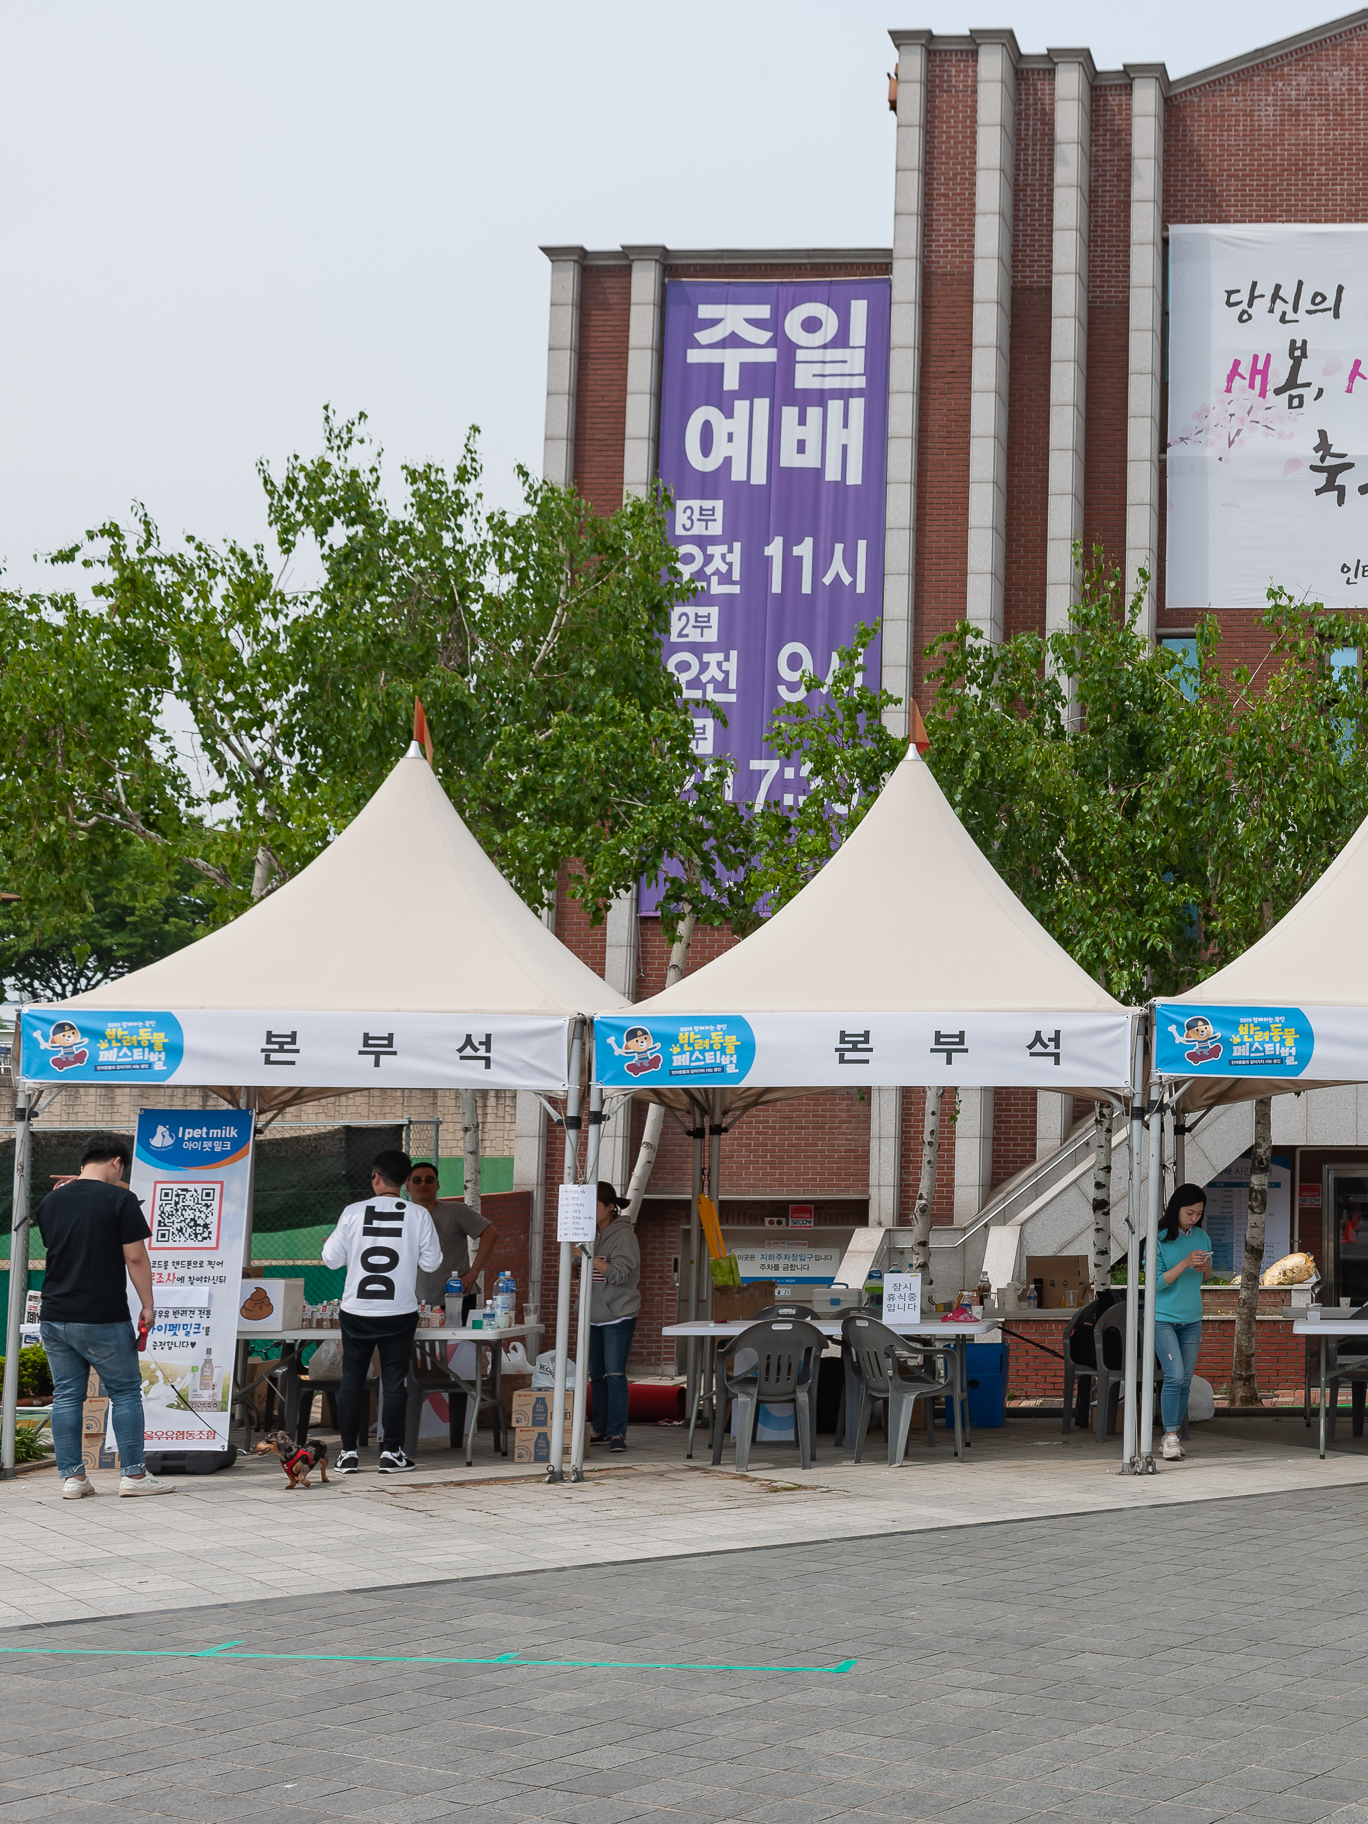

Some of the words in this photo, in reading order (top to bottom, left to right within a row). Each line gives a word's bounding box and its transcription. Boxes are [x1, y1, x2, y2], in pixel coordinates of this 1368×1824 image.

[1225, 280, 1345, 324] 당신의
[687, 299, 869, 391] 주일
[1225, 339, 1325, 410] 새봄,
[685, 397, 866, 486] 예배
[681, 504, 717, 532] 3부
[672, 542, 741, 594] 오전
[764, 536, 868, 594] 11시
[677, 611, 713, 639] 2부
[666, 650, 738, 702] 오전
[105, 1028, 169, 1051] 반려동물
[678, 1031, 741, 1054] 반려동물
[1238, 1023, 1300, 1046] 반려동물
[98, 1046, 167, 1070] 페스티벌
[672, 1050, 739, 1074] 페스티벌
[1232, 1041, 1298, 1065] 페스티벌
[184, 1126, 208, 1140] pet
[209, 1126, 238, 1138] milk
[171, 1260, 204, 1270] 핸드폰으로
[207, 1260, 224, 1270] 찍어
[737, 1254, 756, 1262] 이곳은
[759, 1263, 780, 1271] 주차를
[782, 1263, 810, 1271] 금합니다
[356, 1246, 400, 1301] DO
[887, 1292, 917, 1302] 휴식중
[892, 1283, 912, 1291] 잠시
[172, 1309, 195, 1319] 반려견
[197, 1309, 212, 1319] 전용
[887, 1303, 917, 1312] 입니다
